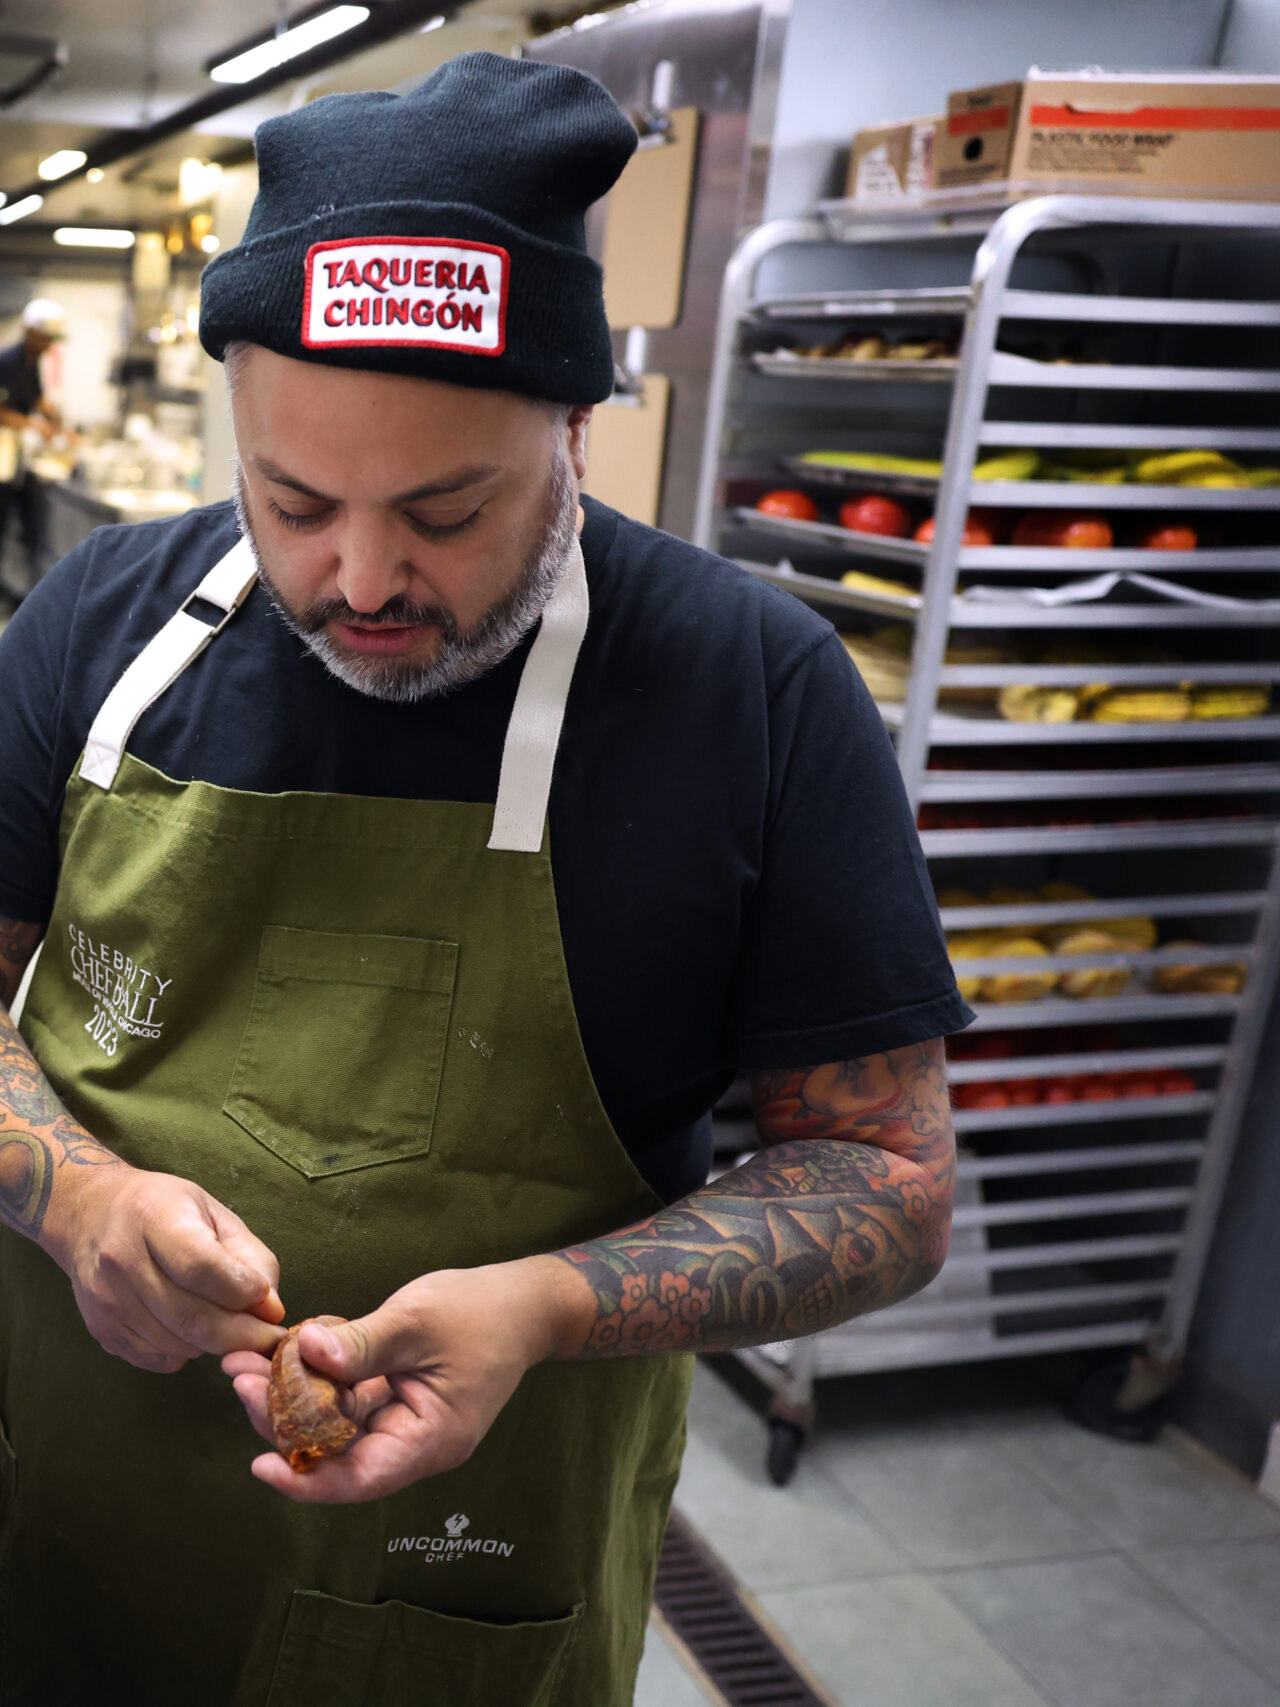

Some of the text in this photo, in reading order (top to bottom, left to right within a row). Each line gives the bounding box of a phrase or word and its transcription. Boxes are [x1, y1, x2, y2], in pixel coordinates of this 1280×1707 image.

[323, 257, 489, 294] TAQUERIA
[323, 292, 483, 333] CHINGÓN
[69, 923, 173, 996] CELEBRITY
[71, 945, 164, 1028] CHEF BALL
[85, 1004, 118, 1056] 2023
[387, 1536, 515, 1558] UNCOMMON
[425, 1551, 465, 1564] CHEF
